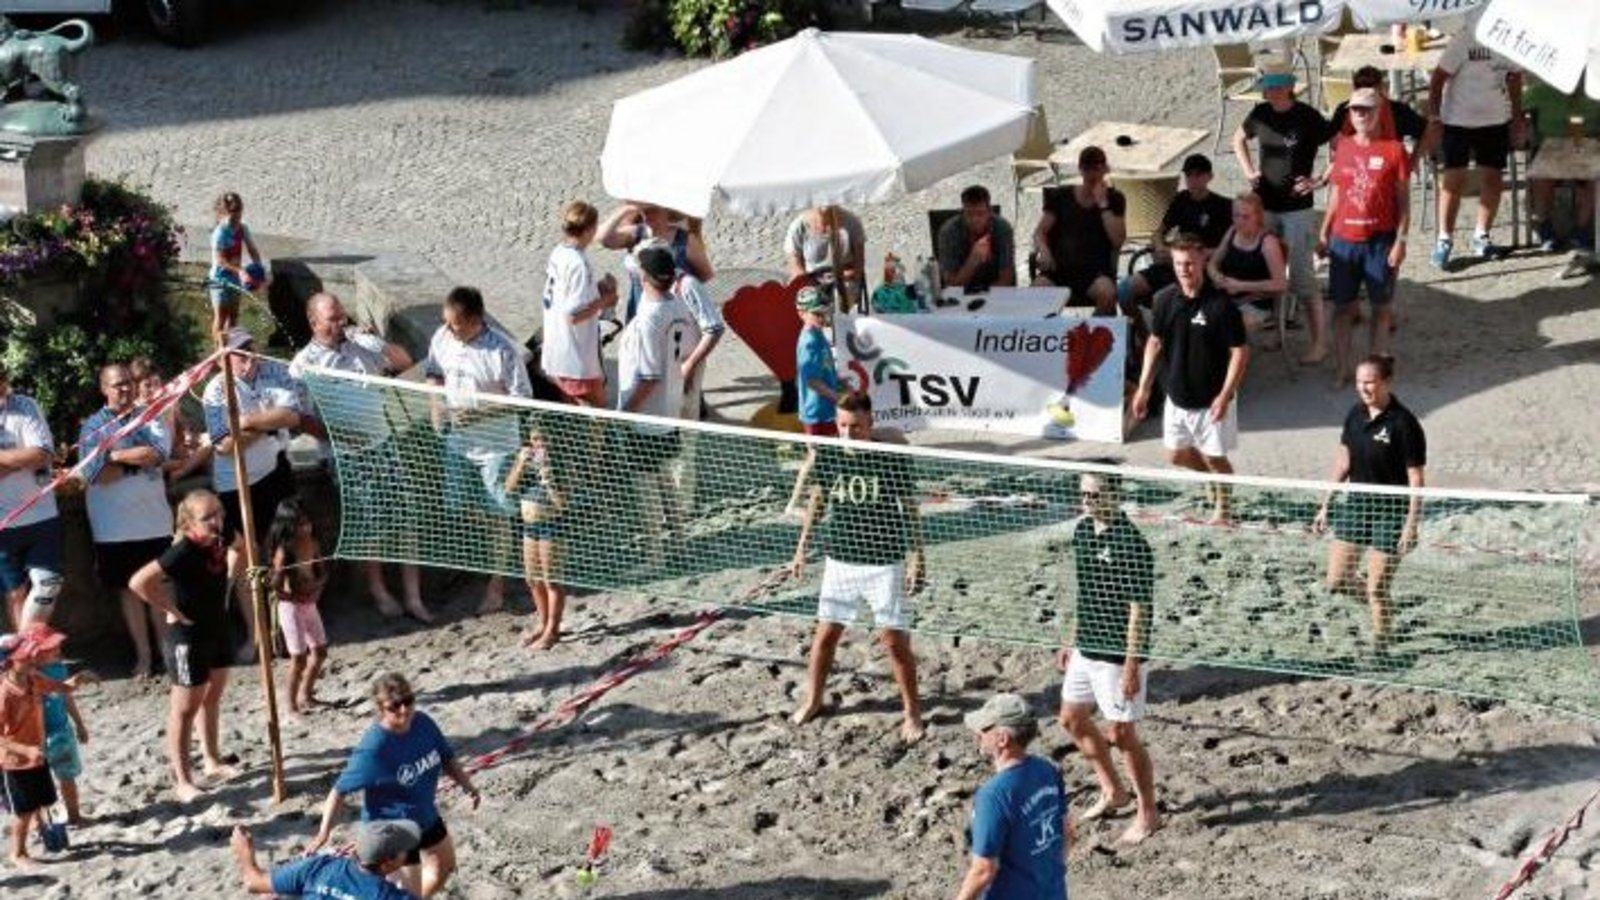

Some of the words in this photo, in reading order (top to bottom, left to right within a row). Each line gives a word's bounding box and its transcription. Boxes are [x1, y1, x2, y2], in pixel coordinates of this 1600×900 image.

[1123, 1, 1323, 42] SANWALD
[889, 374, 980, 408] TSV
[830, 474, 878, 505] 401
